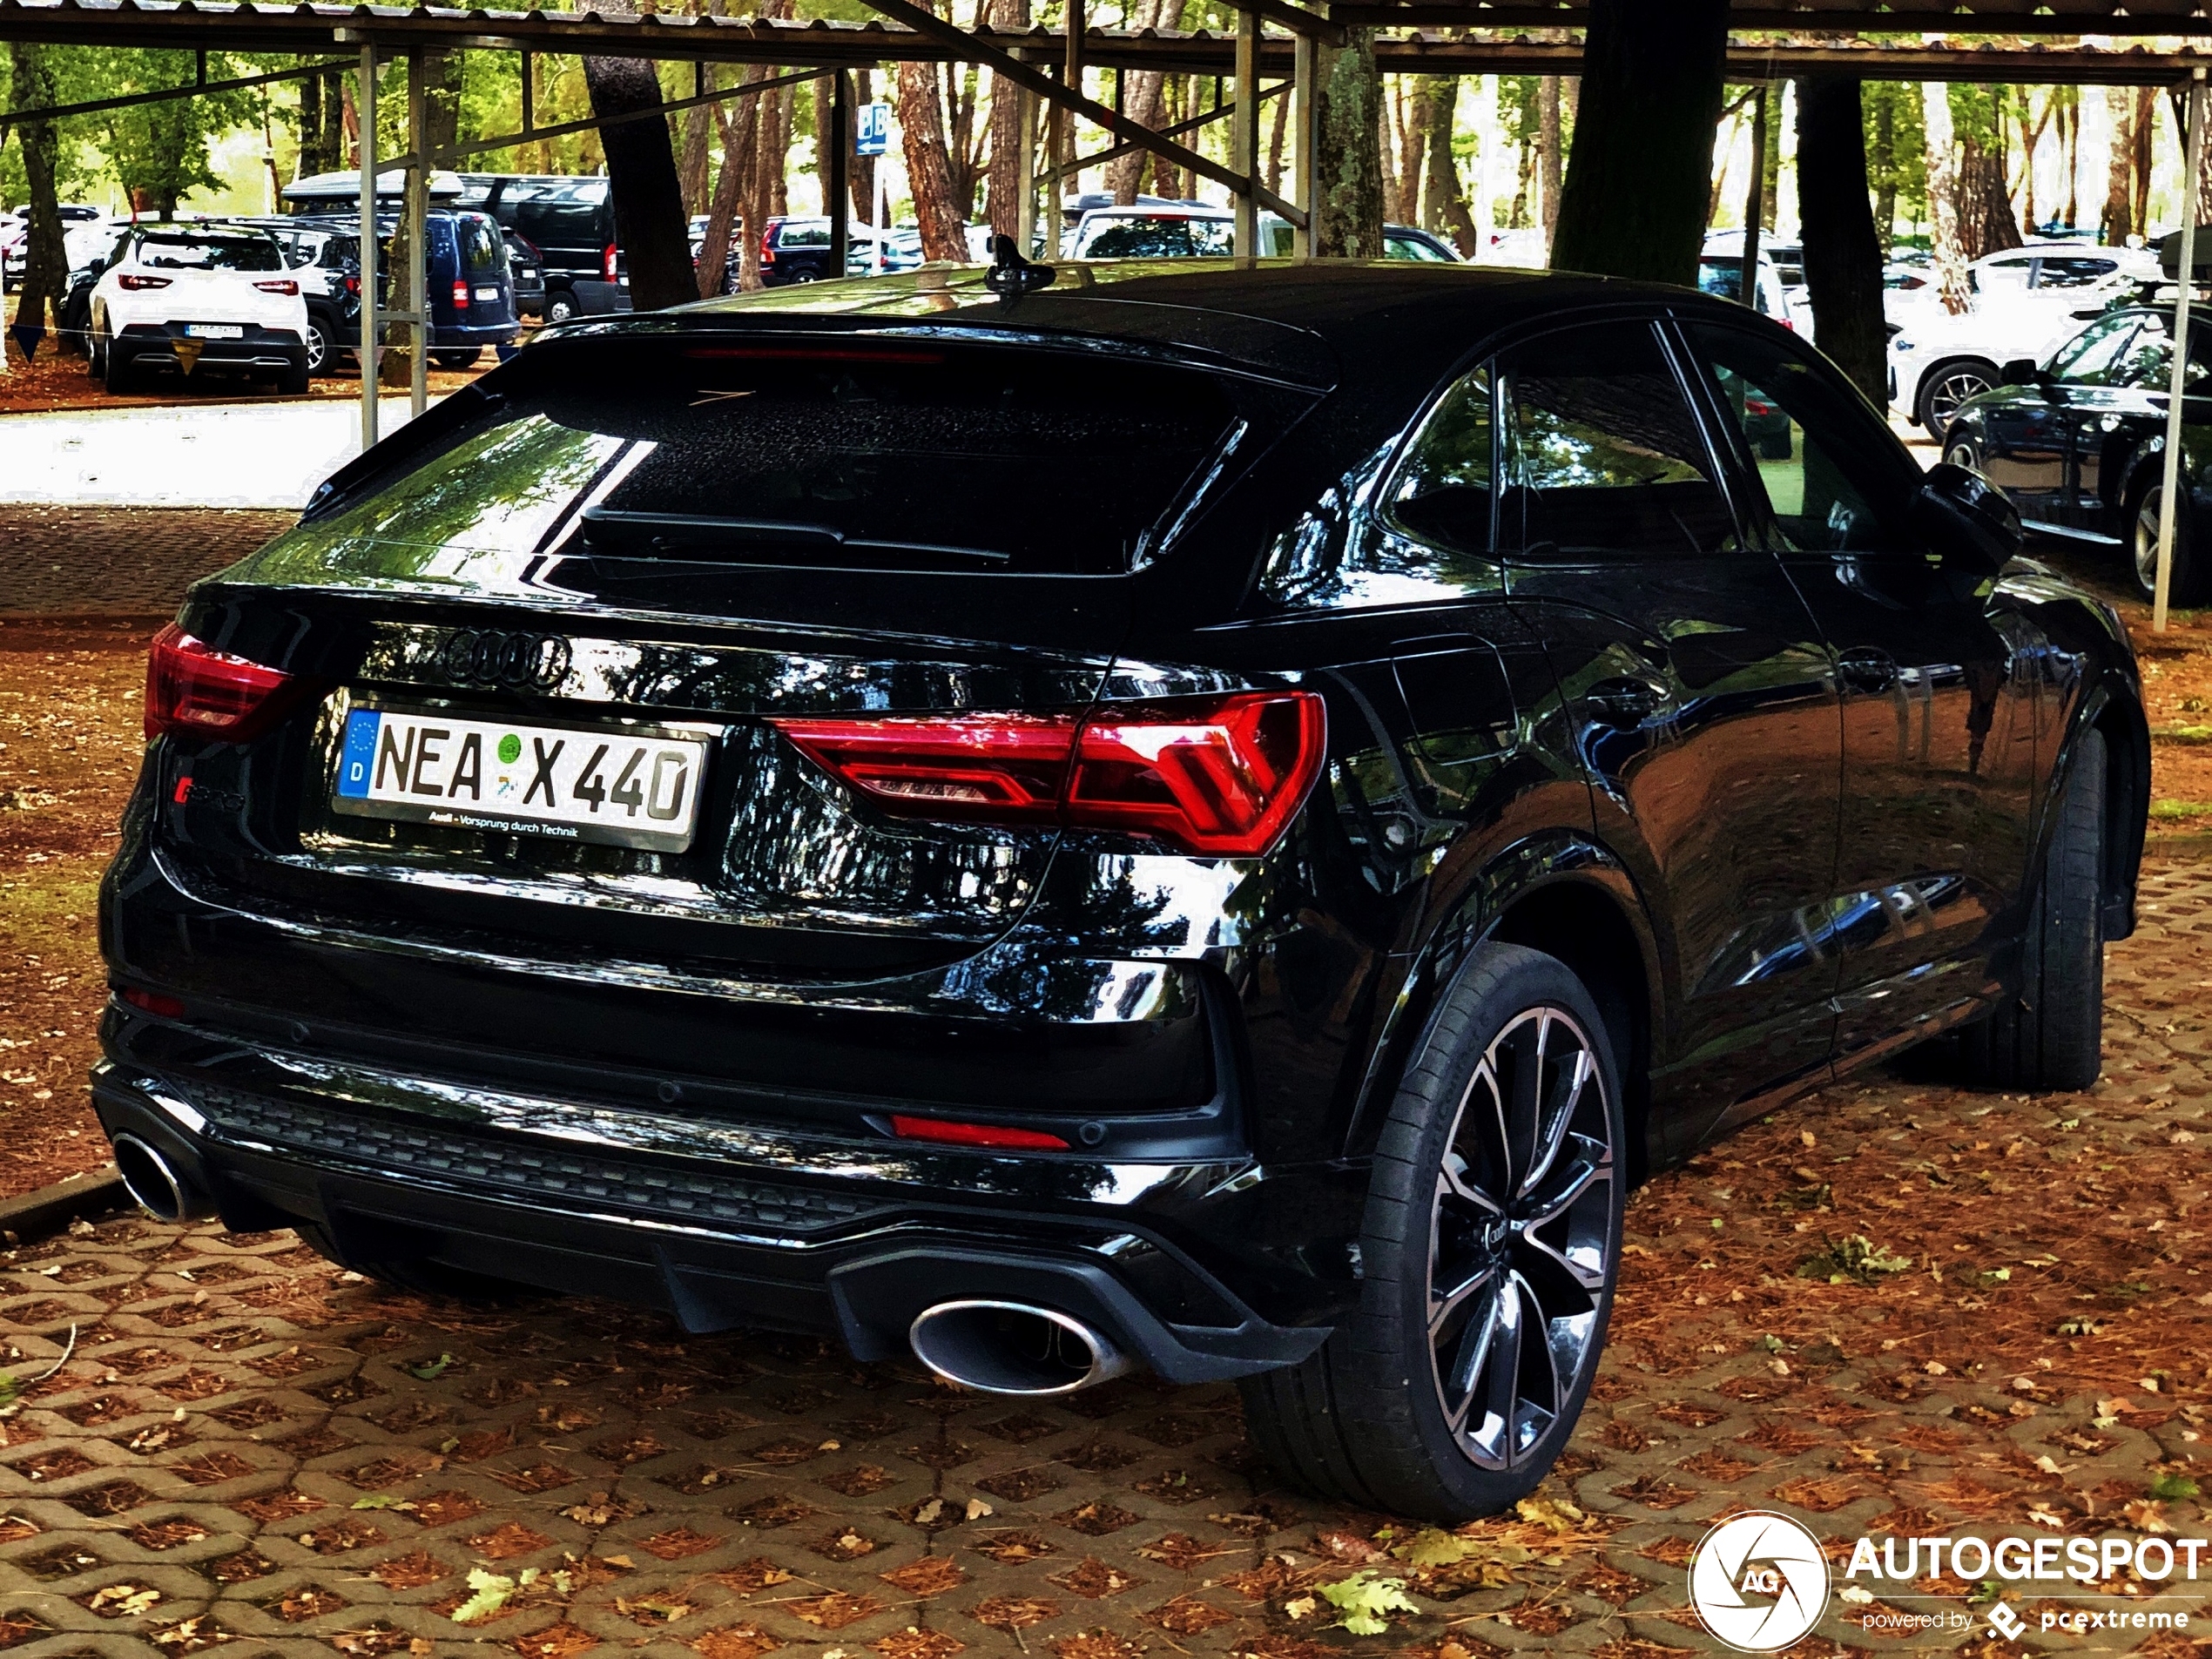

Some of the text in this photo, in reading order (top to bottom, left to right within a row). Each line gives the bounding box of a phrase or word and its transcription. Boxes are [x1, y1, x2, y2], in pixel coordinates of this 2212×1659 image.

[350, 761, 363, 782] D
[374, 725, 482, 800] NEA
[523, 737, 565, 807] X
[573, 745, 688, 820] 440
[428, 811, 453, 822] Audi
[460, 814, 509, 832] Vorsprung
[510, 821, 539, 833] durch
[541, 824, 579, 838] Technik
